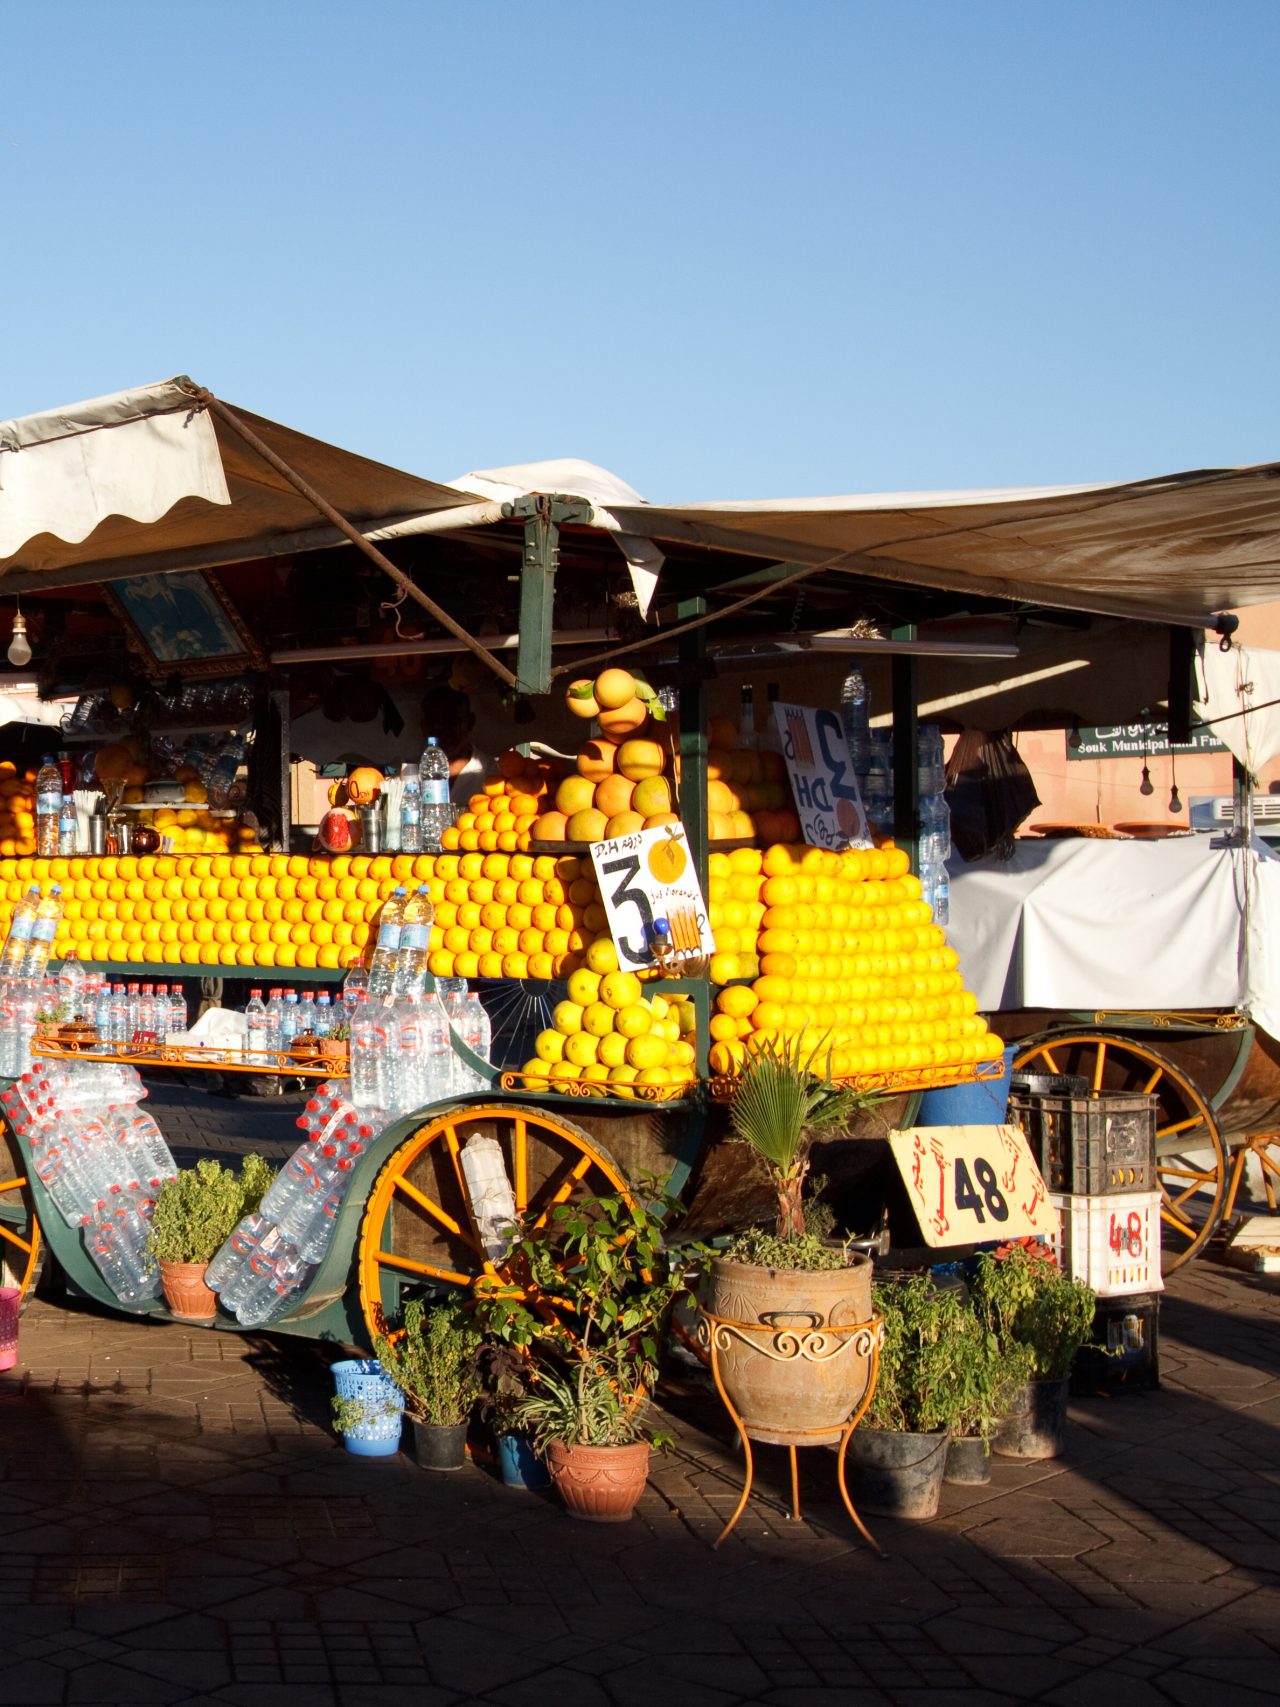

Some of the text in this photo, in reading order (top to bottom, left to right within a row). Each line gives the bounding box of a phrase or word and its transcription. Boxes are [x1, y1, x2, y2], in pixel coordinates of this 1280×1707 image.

[1078, 742, 1107, 753] Souk
[1112, 739, 1169, 754] Municipal
[602, 854, 656, 965] 3
[955, 1157, 1009, 1224] 48
[1109, 1211, 1142, 1258] 48
